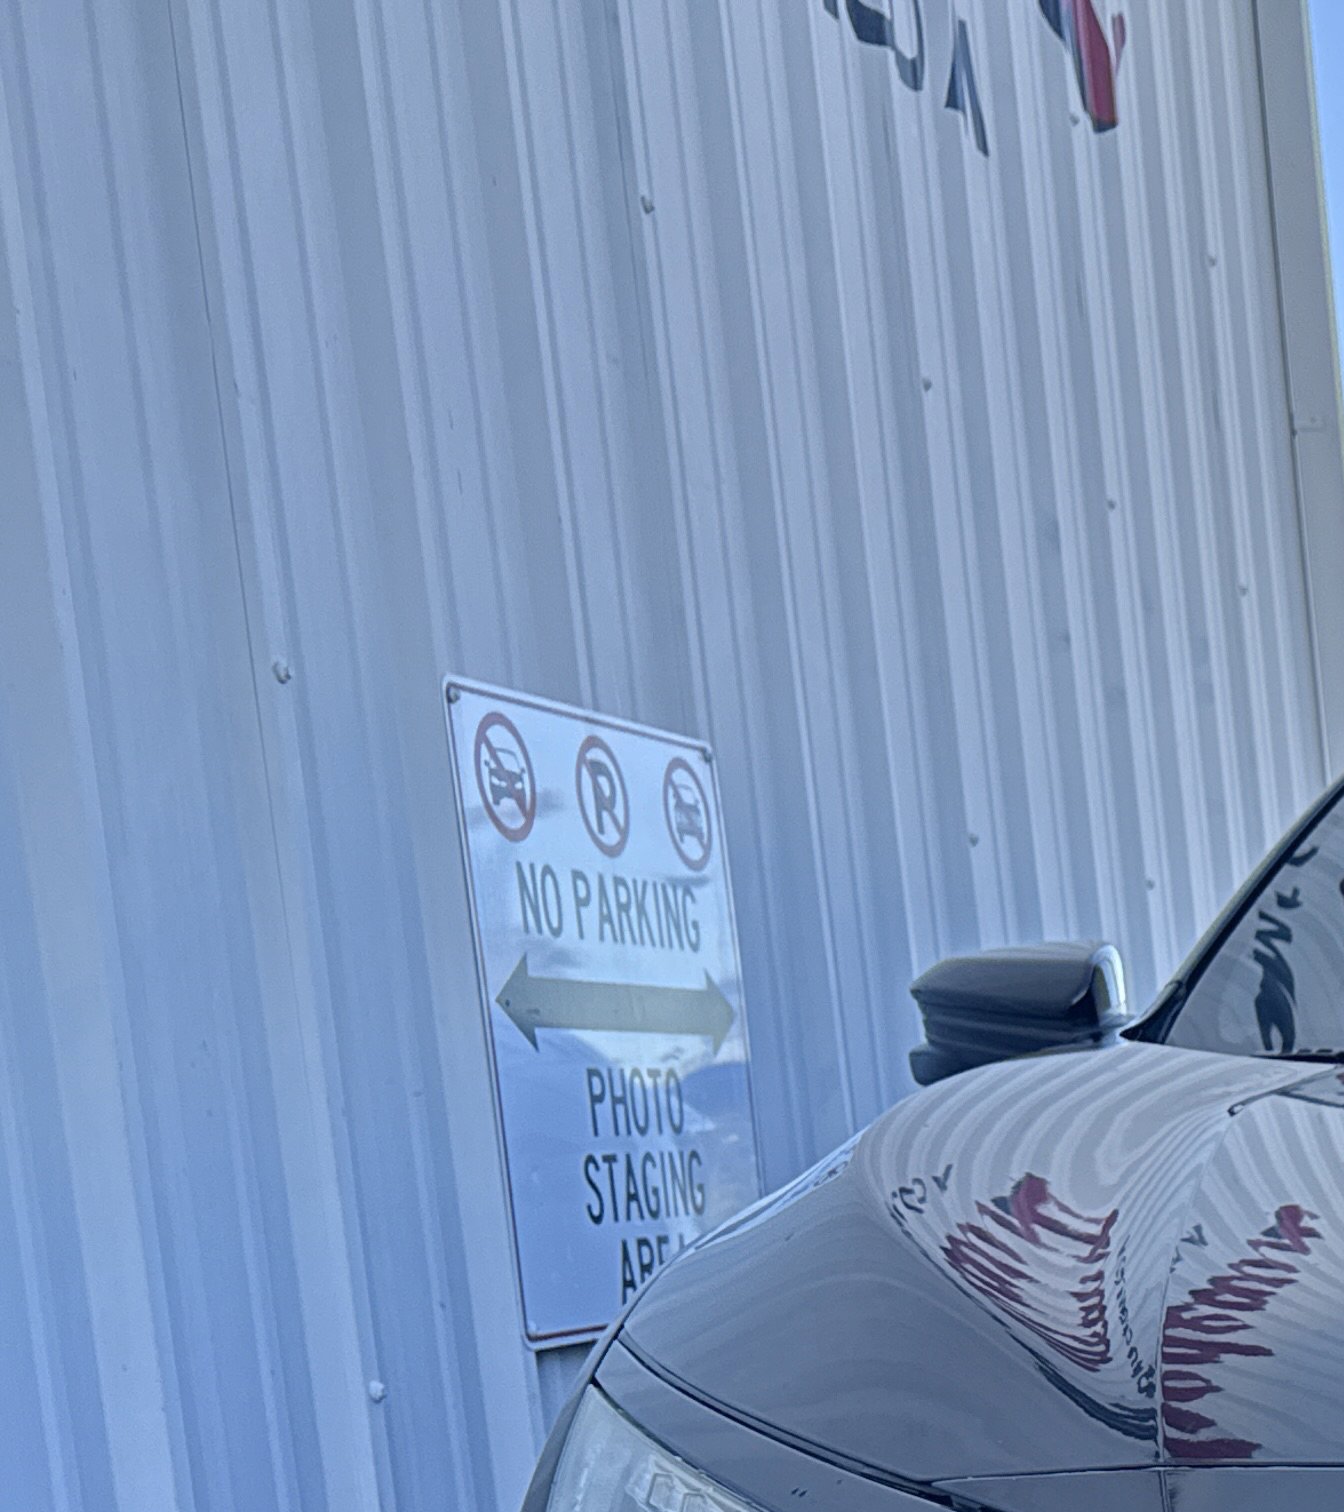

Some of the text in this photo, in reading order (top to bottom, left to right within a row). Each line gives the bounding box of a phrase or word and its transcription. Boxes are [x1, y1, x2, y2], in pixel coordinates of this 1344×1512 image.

[515, 860, 701, 953] NO PARKING
[586, 1066, 684, 1138] PHOTO
[583, 1149, 706, 1226] STAGING
[621, 1232, 686, 1306] AR
